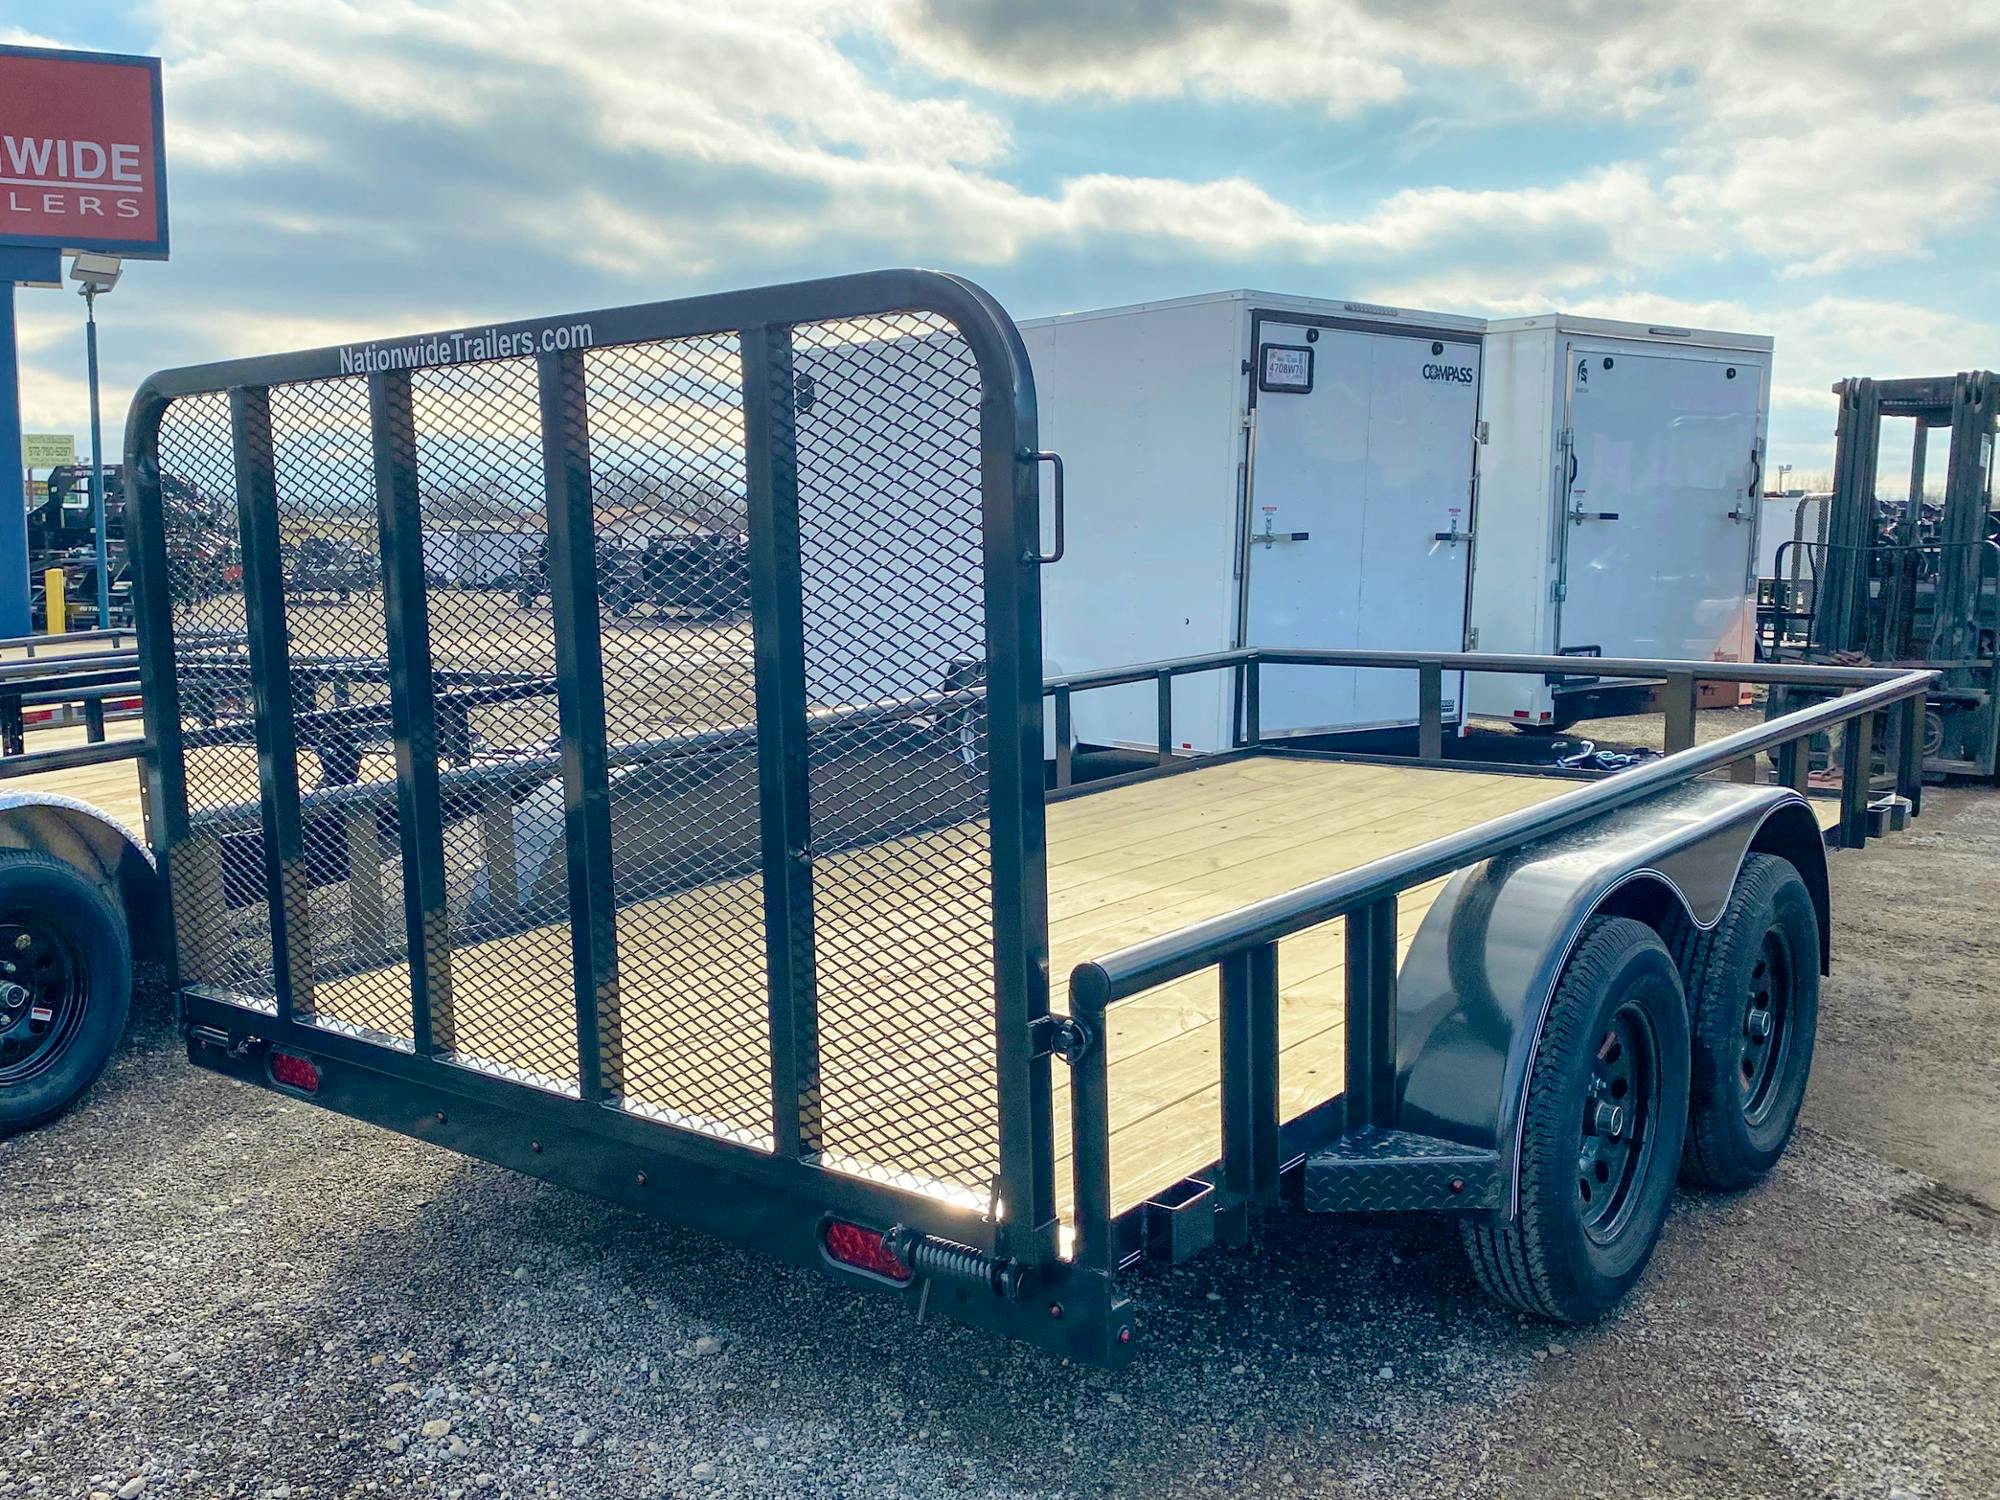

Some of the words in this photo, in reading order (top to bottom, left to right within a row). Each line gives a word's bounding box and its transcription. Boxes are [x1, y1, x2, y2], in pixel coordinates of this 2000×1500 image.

[0, 136, 142, 182] WIDE
[339, 323, 594, 374] NationwideTrailers.com
[1422, 364, 1473, 383] COMPASS
